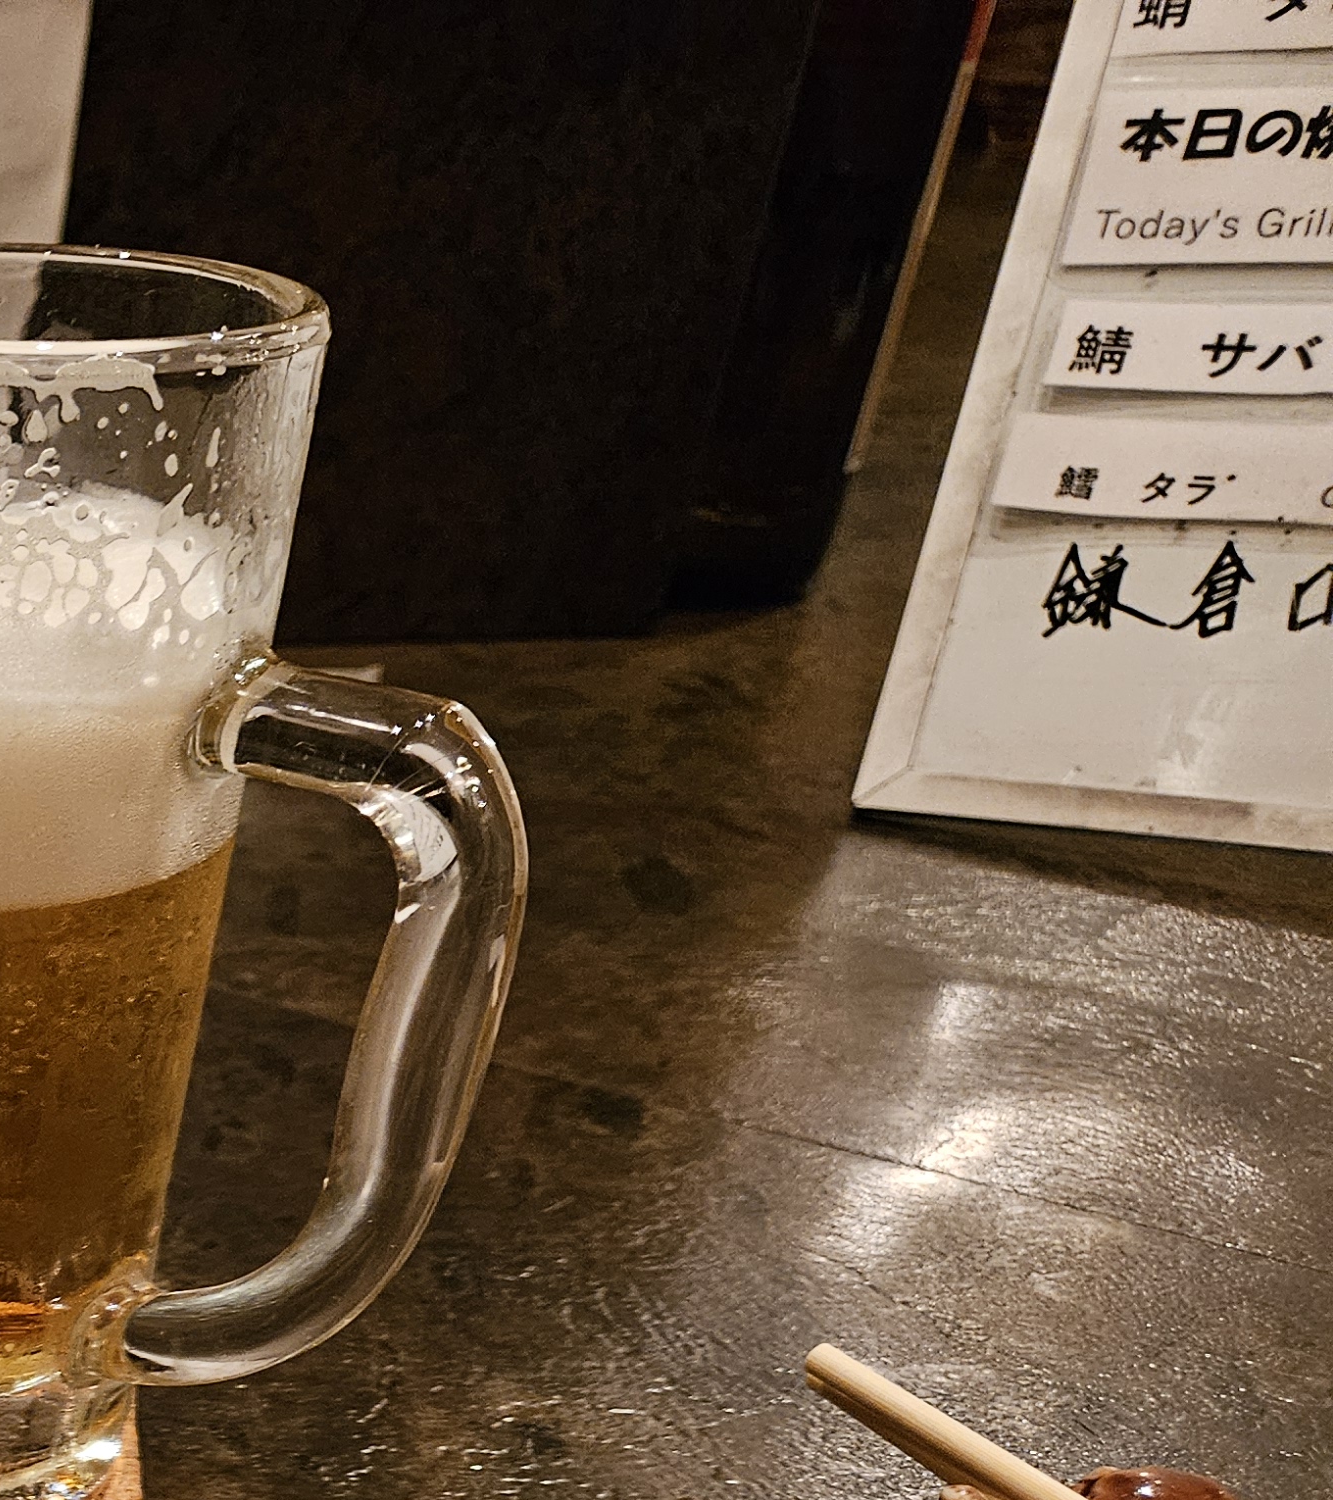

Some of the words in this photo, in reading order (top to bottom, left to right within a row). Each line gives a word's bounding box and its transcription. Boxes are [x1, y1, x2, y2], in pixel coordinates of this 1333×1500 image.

[1098, 207, 1240, 246] Today's
[1068, 325, 1133, 375] 鯖
[1201, 332, 1323, 377] サバ
